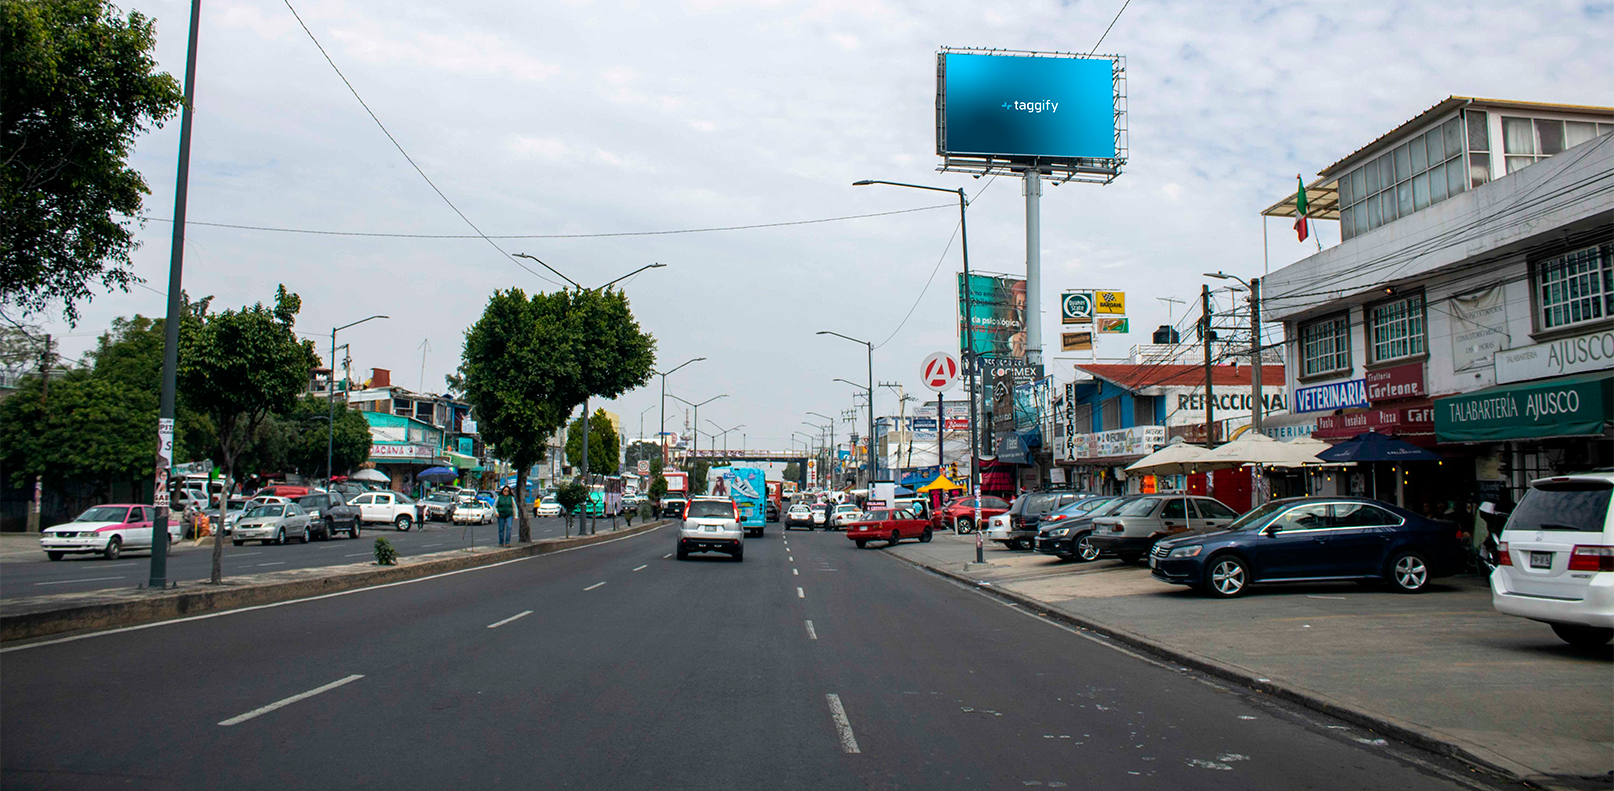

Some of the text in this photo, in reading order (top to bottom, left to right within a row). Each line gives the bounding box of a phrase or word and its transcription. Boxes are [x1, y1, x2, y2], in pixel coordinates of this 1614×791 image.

[1014, 99, 1059, 113] taggify
[1547, 332, 1614, 374] AJUSCO
[1297, 380, 1367, 411] VETERINARIA
[1369, 382, 1418, 399] Corleone
[1178, 394, 1287, 410] REFACCIONA
[1449, 390, 1580, 423] TALABARTERÍA AJUSCO
[1380, 410, 1396, 424] Pizza
